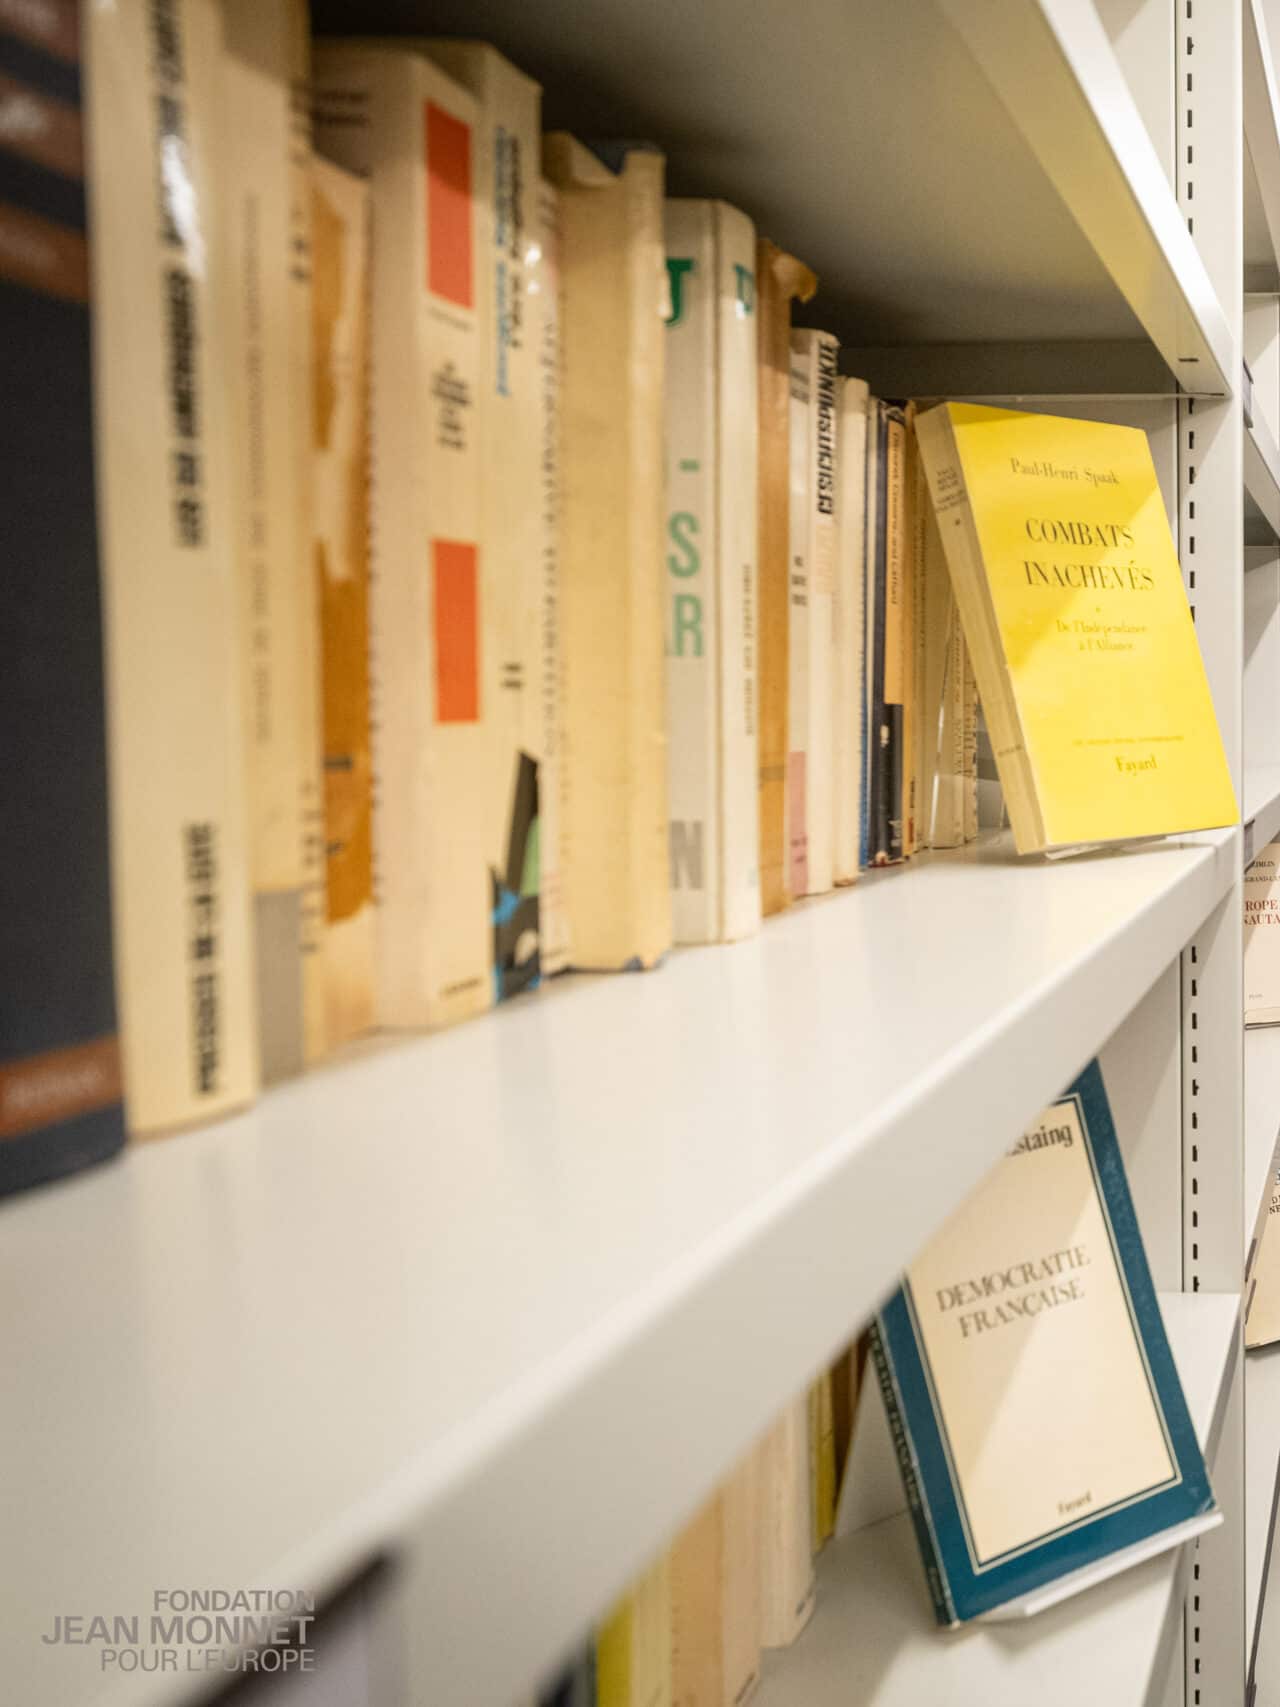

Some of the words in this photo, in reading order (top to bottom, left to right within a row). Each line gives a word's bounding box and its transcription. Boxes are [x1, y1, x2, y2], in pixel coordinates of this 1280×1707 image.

[1010, 457, 1078, 484] Paul-Henri
[1085, 465, 1120, 487] Spaak
[1025, 518, 1135, 549] COMBATS
[1023, 560, 1155, 592] INACHEVÉS
[1115, 753, 1158, 776] Fayard
[959, 1278, 1086, 1339] FRANÇAISE
